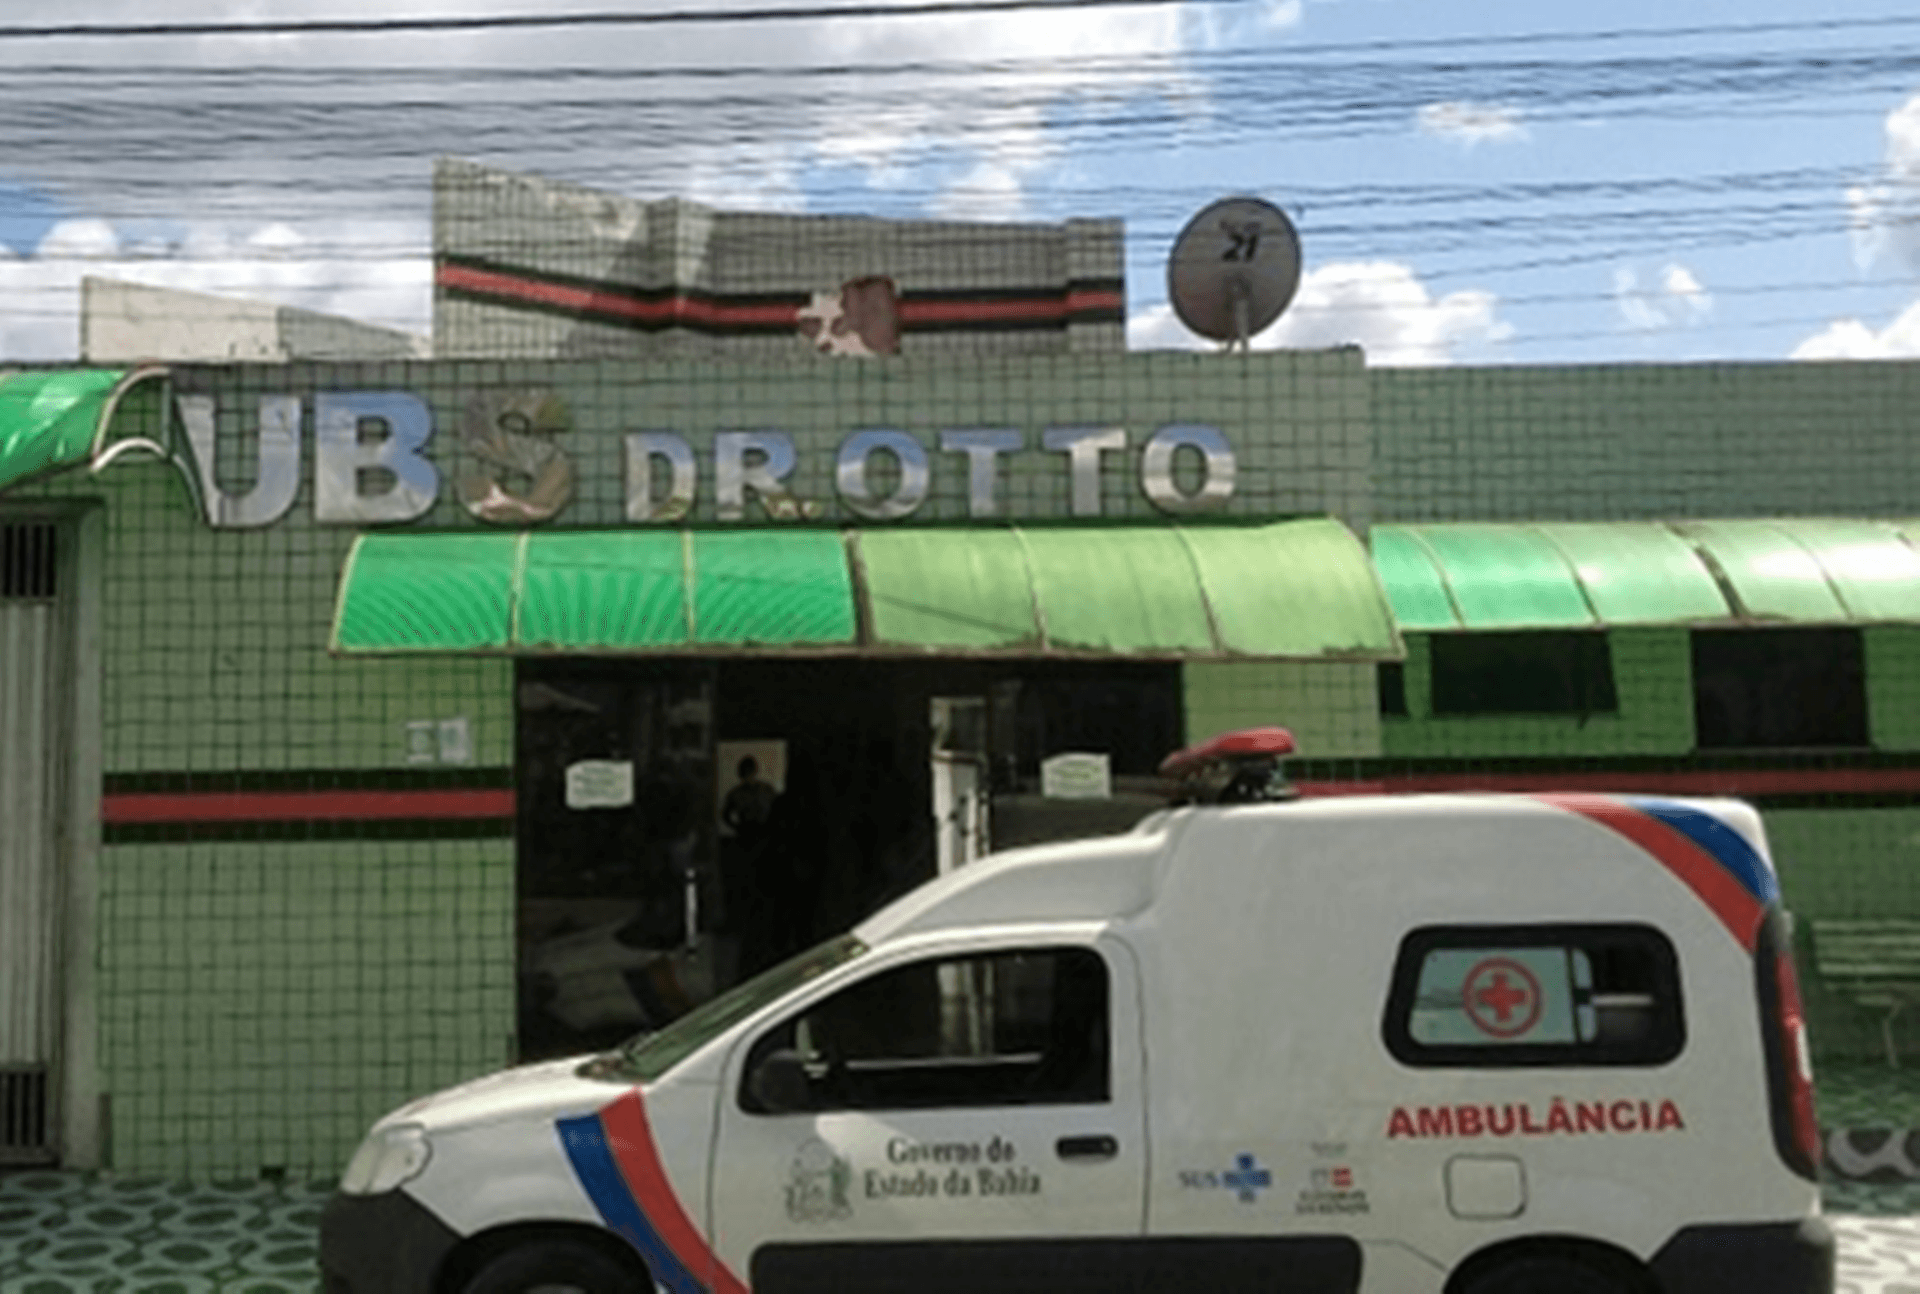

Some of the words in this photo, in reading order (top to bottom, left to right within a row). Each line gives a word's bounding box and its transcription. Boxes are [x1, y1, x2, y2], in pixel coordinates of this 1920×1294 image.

[175, 391, 574, 528] UBS
[837, 423, 1237, 519] OTTO
[1387, 1096, 1686, 1138] AMBULÂNCIA
[886, 1137, 981, 1164] Governo
[986, 1135, 1015, 1163] do
[864, 1169, 938, 1198] Estado
[943, 1169, 971, 1196] da
[976, 1166, 1041, 1196] Bahia
